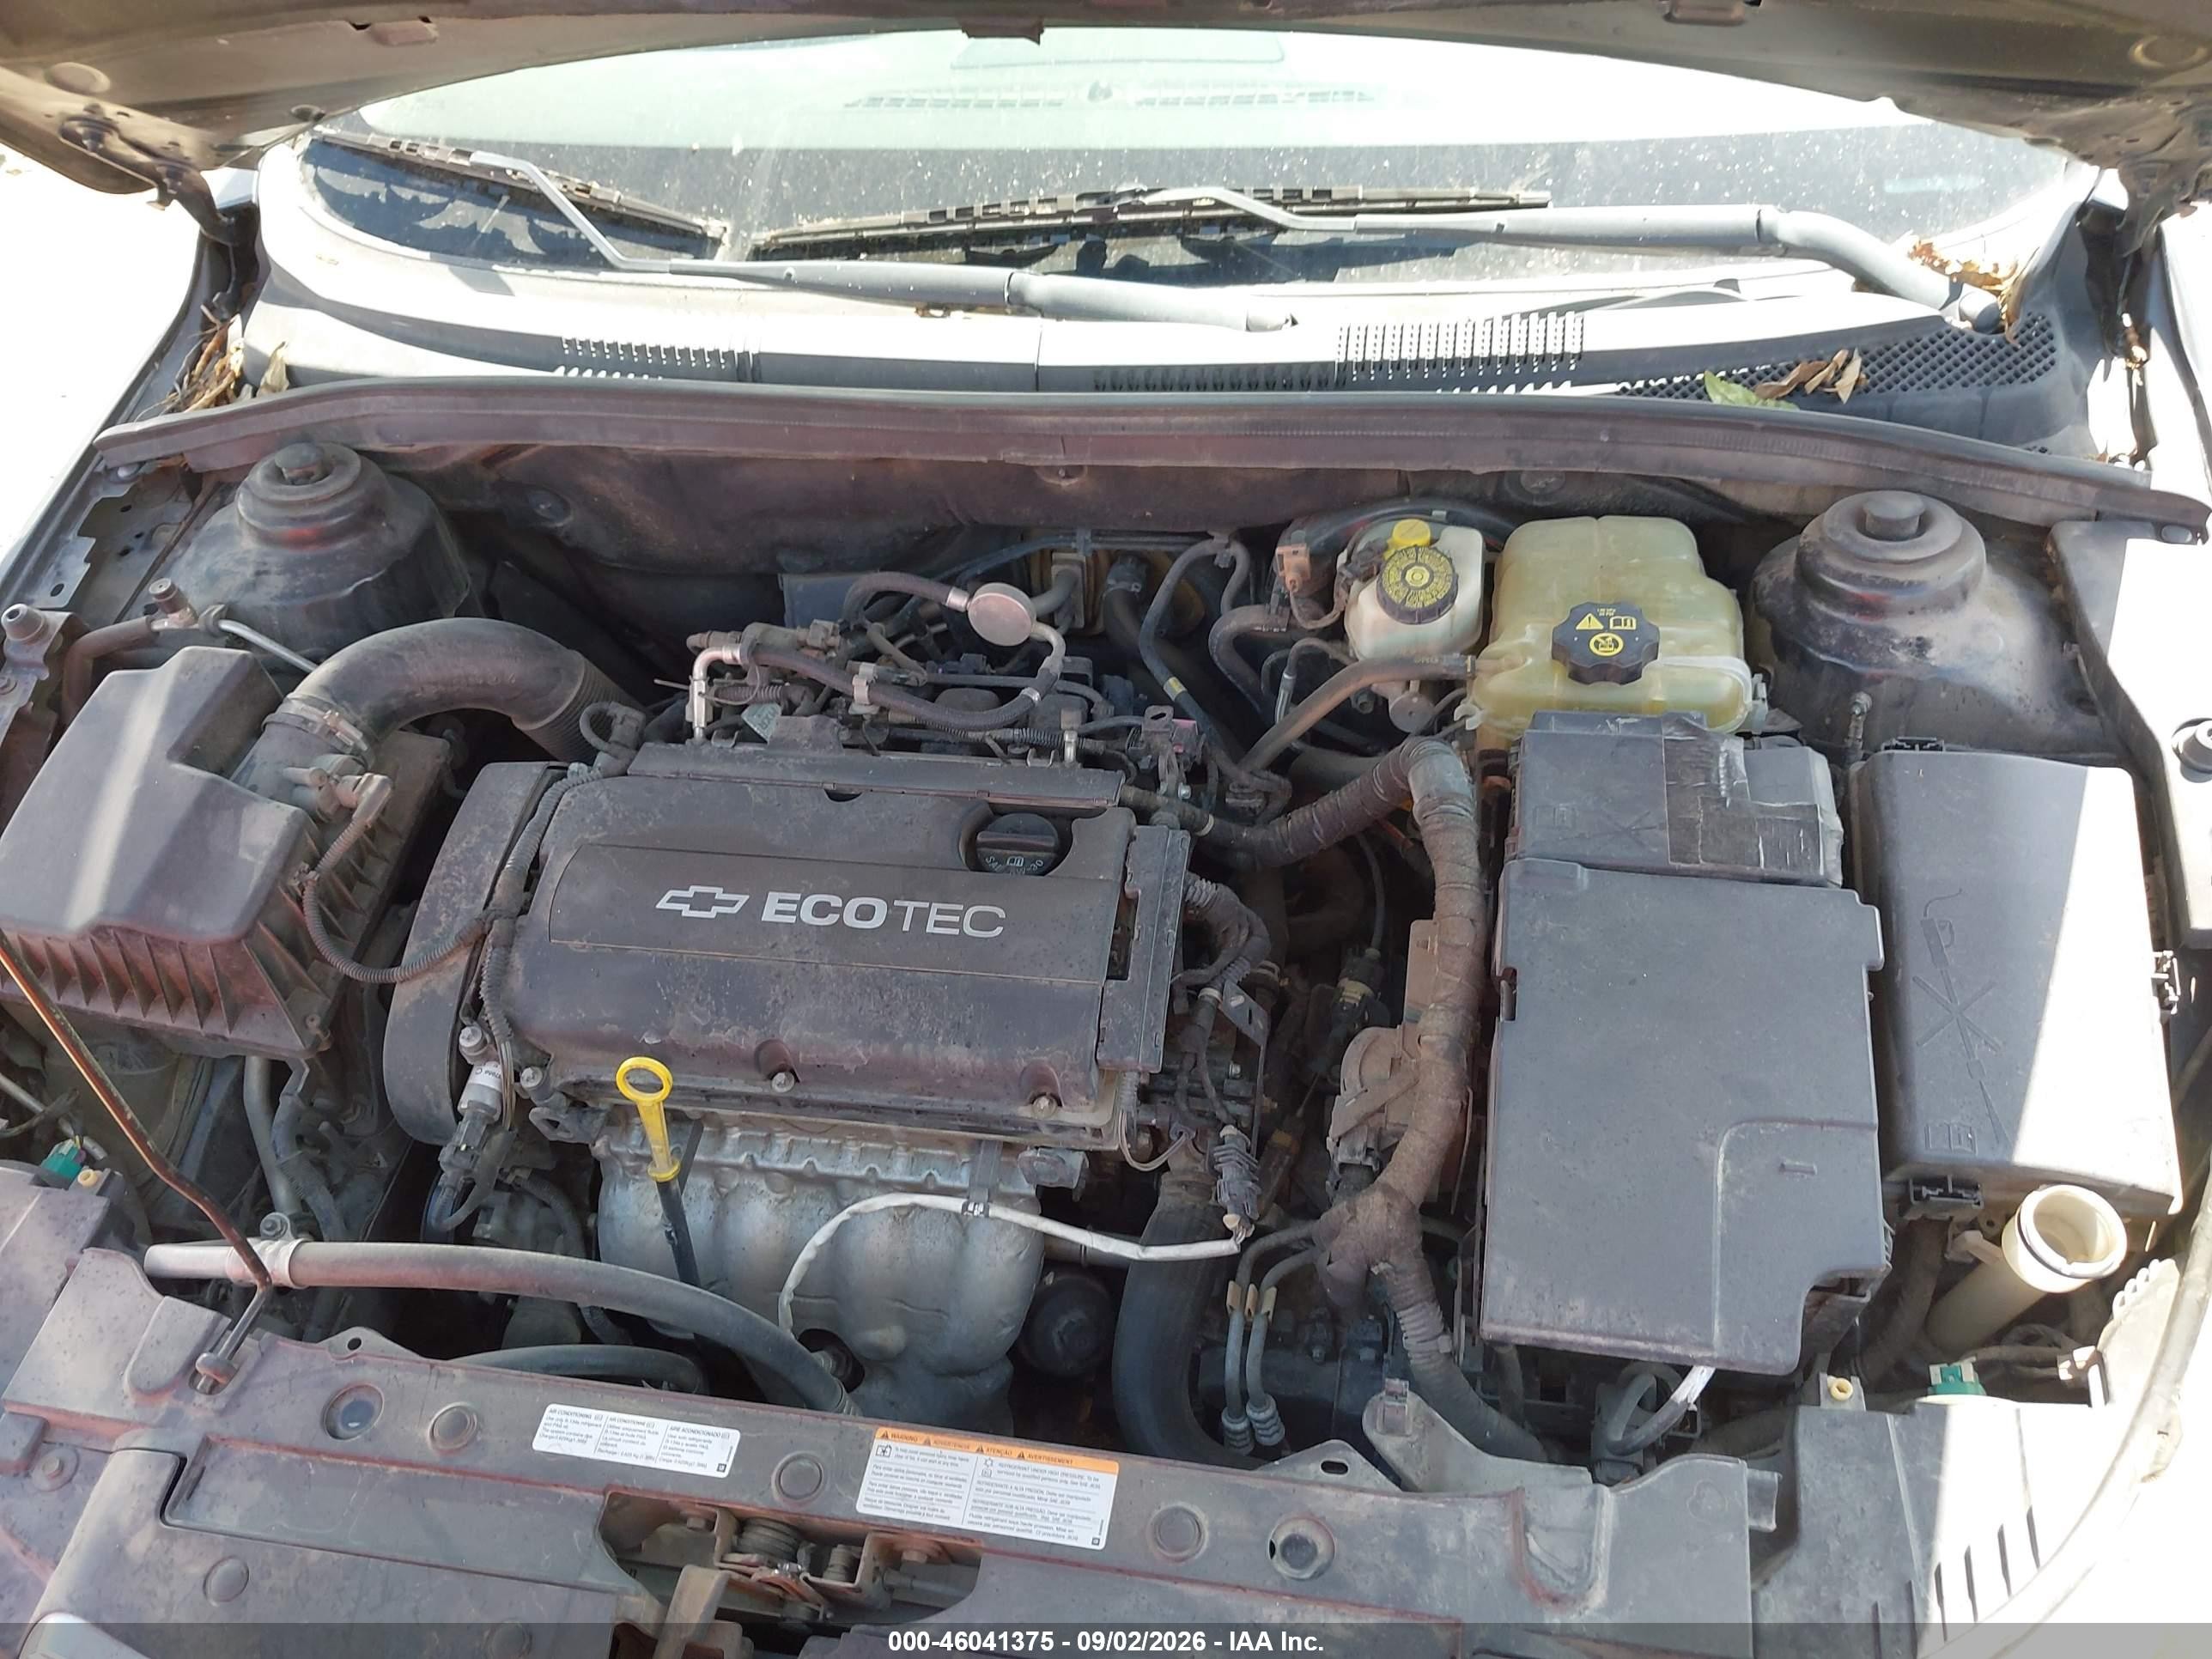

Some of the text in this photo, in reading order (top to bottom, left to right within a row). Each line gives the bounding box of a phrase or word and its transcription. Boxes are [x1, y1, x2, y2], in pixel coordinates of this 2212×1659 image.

[761, 890, 1007, 938] ECOTEC
[890, 1431, 918, 1443] WARNING
[1026, 1452, 1073, 1465] AVERTISSEMENT
